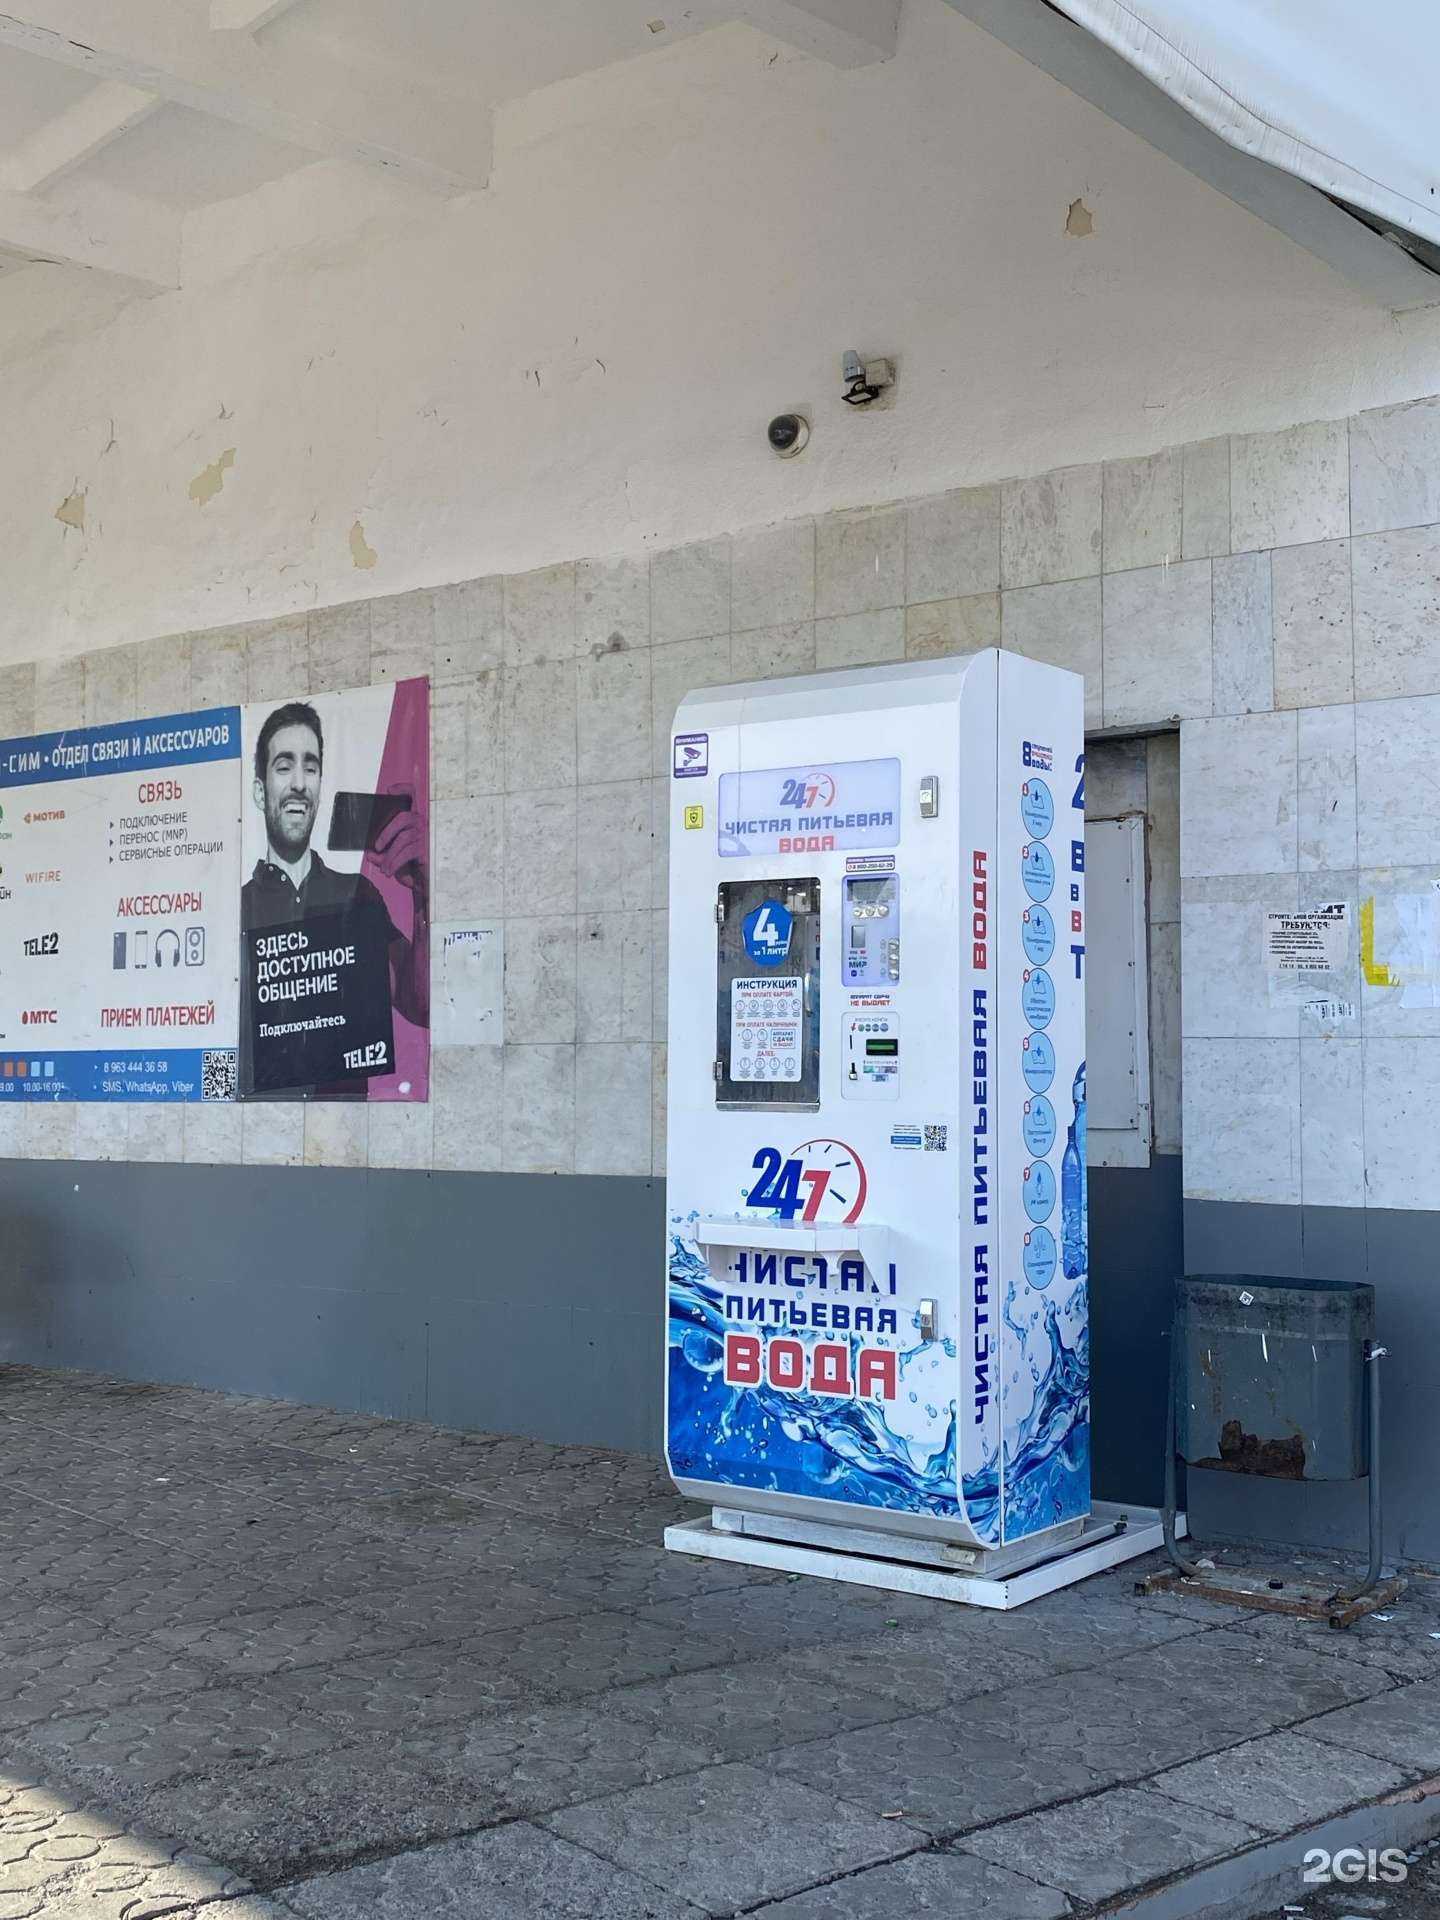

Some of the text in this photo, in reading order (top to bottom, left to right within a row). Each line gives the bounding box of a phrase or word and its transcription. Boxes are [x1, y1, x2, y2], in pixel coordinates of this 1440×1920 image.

[52, 745, 89, 770] ОТДЕЛ
[92, 739, 130, 763] СВЯЗИ
[132, 738, 141, 755] И
[144, 724, 230, 753] АКСЕССУАРОВ
[138, 780, 182, 804] СВЯЗЬ
[119, 811, 188, 829] ПОДКЛЮЧЕНИЕ
[725, 812, 893, 835] ЧИСТАЯ ПИТЬЕВАЯ
[119, 827, 189, 846] ПЕРЕНОС (MNP)
[778, 835, 835, 853] ВОДА
[119, 840, 224, 862] СЕРВИСНЫЕ ОПЕРАЦИИ
[25, 870, 62, 884] WIFIRE
[117, 891, 202, 917] АКСЕССУАРЫ
[752, 907, 779, 947] 4
[24, 932, 60, 956] TELE2
[256, 931, 308, 958] ЗДЕСЬ
[257, 946, 356, 984] ДОСТУПНОЕ
[258, 973, 338, 1003] ОБЩЕНИЕ
[736, 979, 798, 990] ИНСТРУКЦИЯ
[30, 1010, 58, 1024] МТС
[101, 1000, 215, 1028] ПРИЕМ ПЛАТЕЖЕЙ
[259, 1014, 347, 1037] Подключайтесь
[103, 1061, 168, 1073] 8 963 444 36 58
[344, 1041, 388, 1069] TELE2
[171, 1079, 195, 1093] Viber
[973, 850, 989, 1425] ЧИСТАЯ ПИТЬЕВАЯ ВОДА
[726, 1295, 897, 1334] ПИТЬЕВАЯ
[726, 1334, 896, 1401] ВОДА
